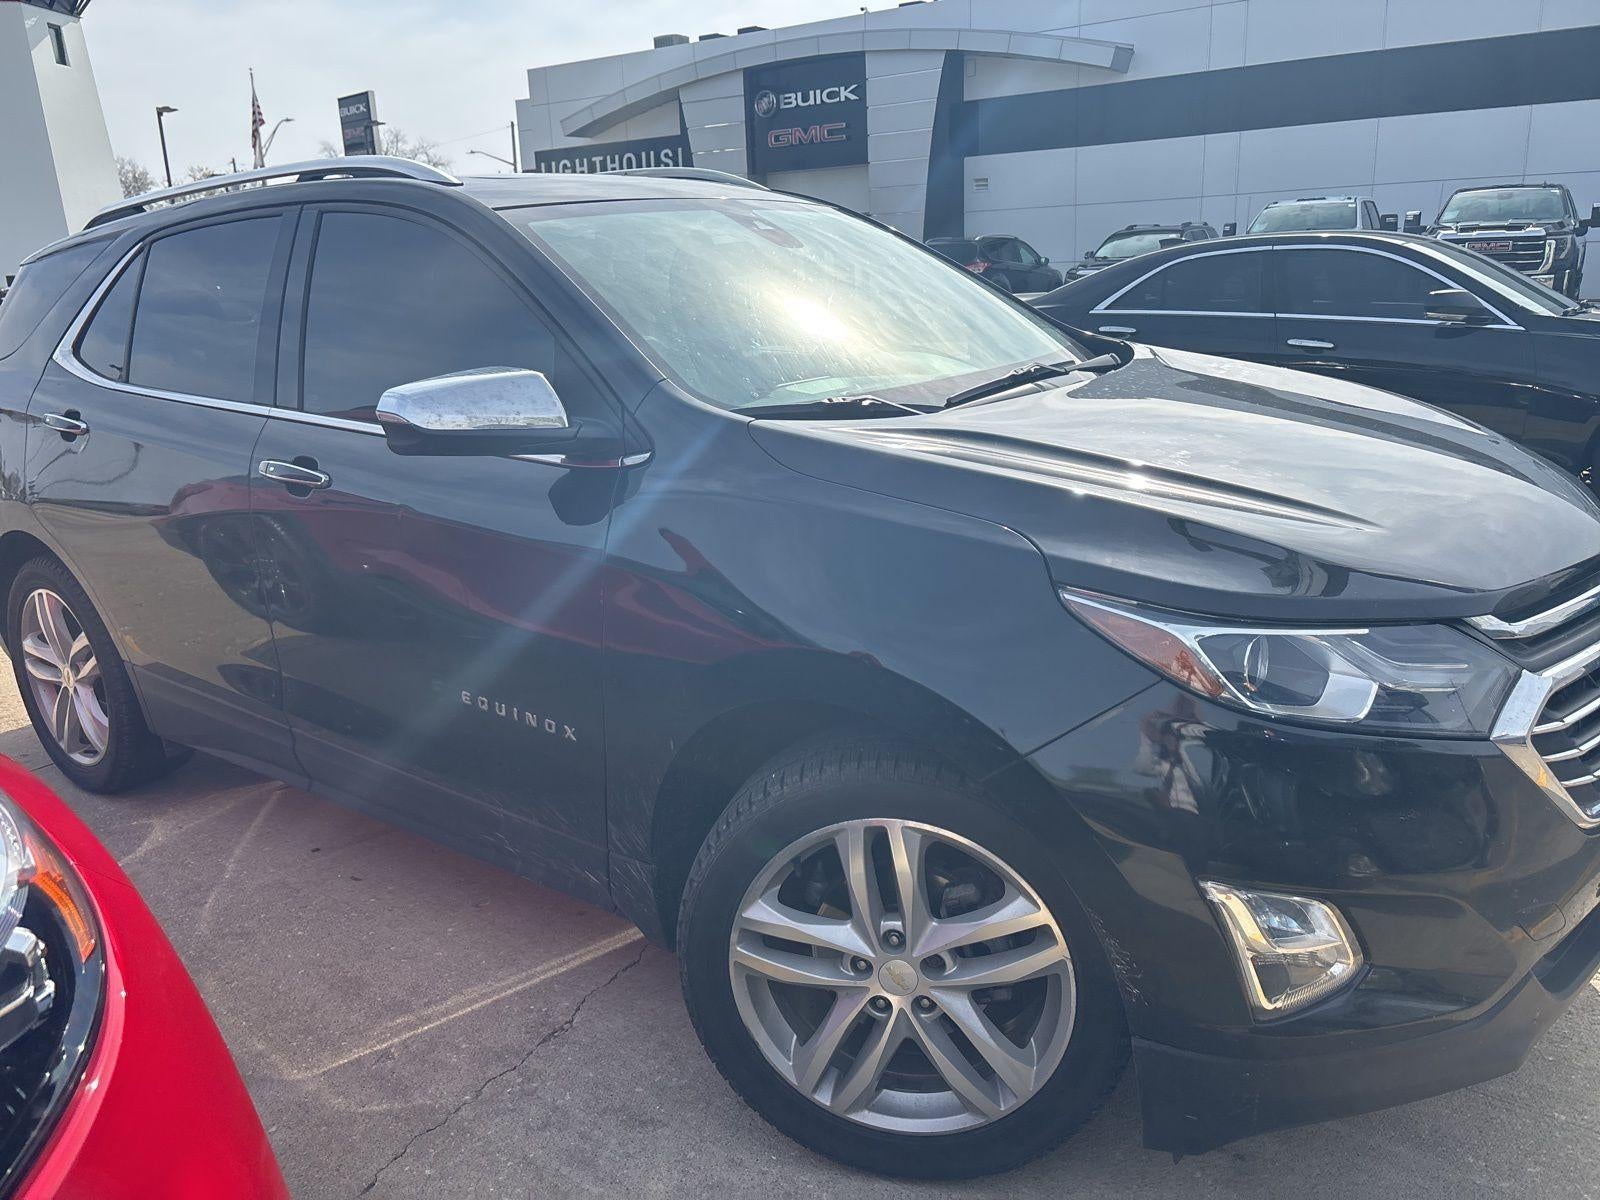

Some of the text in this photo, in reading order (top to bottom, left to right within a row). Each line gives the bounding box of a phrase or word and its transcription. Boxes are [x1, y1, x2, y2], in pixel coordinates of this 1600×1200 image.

[780, 84, 859, 109] BUICK
[340, 102, 367, 117] BUICK
[768, 122, 846, 147] GMC
[461, 690, 577, 741] EQUINOX
